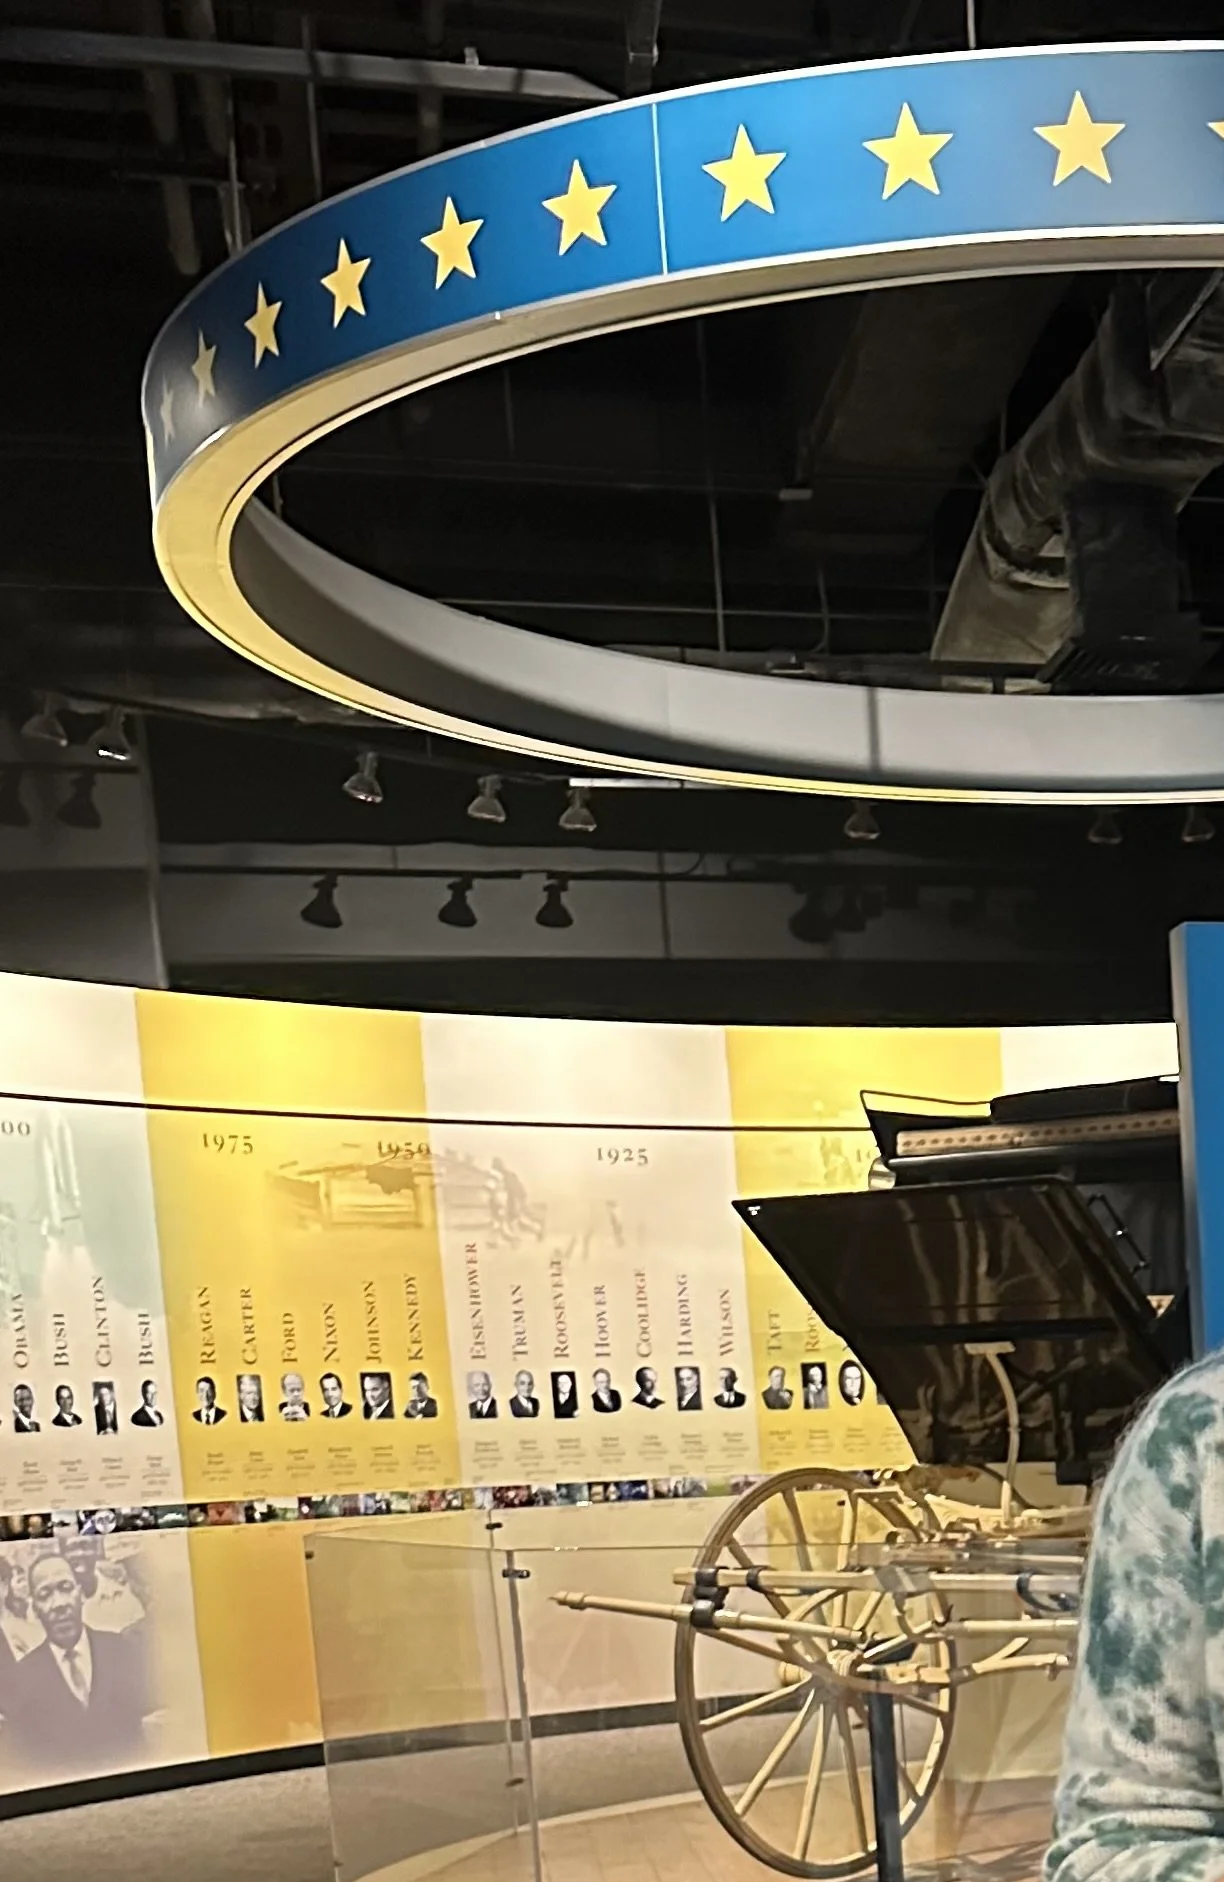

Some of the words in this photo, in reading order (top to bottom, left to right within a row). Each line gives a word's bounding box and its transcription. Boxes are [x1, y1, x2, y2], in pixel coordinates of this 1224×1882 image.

[202, 1132, 254, 1155] 1975
[596, 1147, 650, 1167] 1925
[11, 1293, 29, 1369] OBAMA
[53, 1312, 70, 1367] BUSH
[92, 1275, 112, 1368] CLINTON
[138, 1312, 154, 1366] BUSH
[198, 1286, 217, 1365] REAGAN
[240, 1287, 258, 1365] CARTER
[282, 1312, 298, 1363] FORD
[322, 1302, 340, 1363] NIXON
[361, 1280, 382, 1364] JOHNSON
[403, 1272, 424, 1362] KENNEDY
[465, 1243, 487, 1360] EISENHOWER
[510, 1284, 528, 1361] TRUMAN
[549, 1257, 570, 1358] ROOSEVELT
[593, 1284, 611, 1358] HOOVER
[634, 1267, 653, 1359] COOLIDGE
[677, 1273, 694, 1356] HARDING
[717, 1288, 735, 1357] WILSON
[766, 1309, 783, 1356] TAFT
